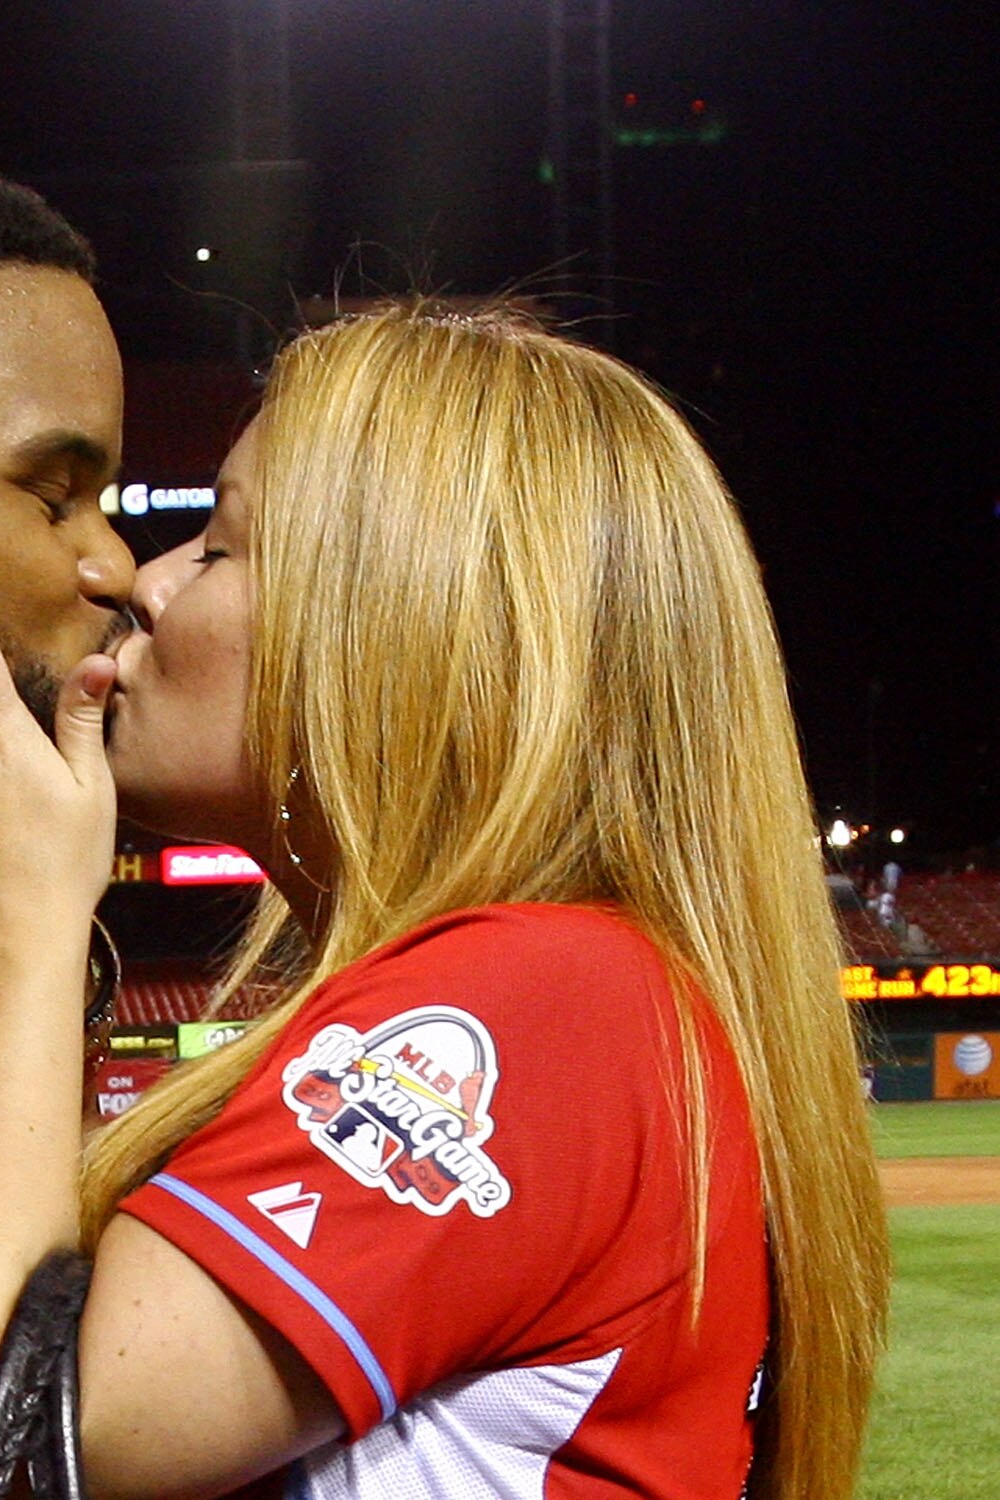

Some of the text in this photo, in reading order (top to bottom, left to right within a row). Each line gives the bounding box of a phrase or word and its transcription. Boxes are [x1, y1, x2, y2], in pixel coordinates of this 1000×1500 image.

[289, 1030, 502, 1208] All Star Game
[395, 1042, 457, 1095] MLB
